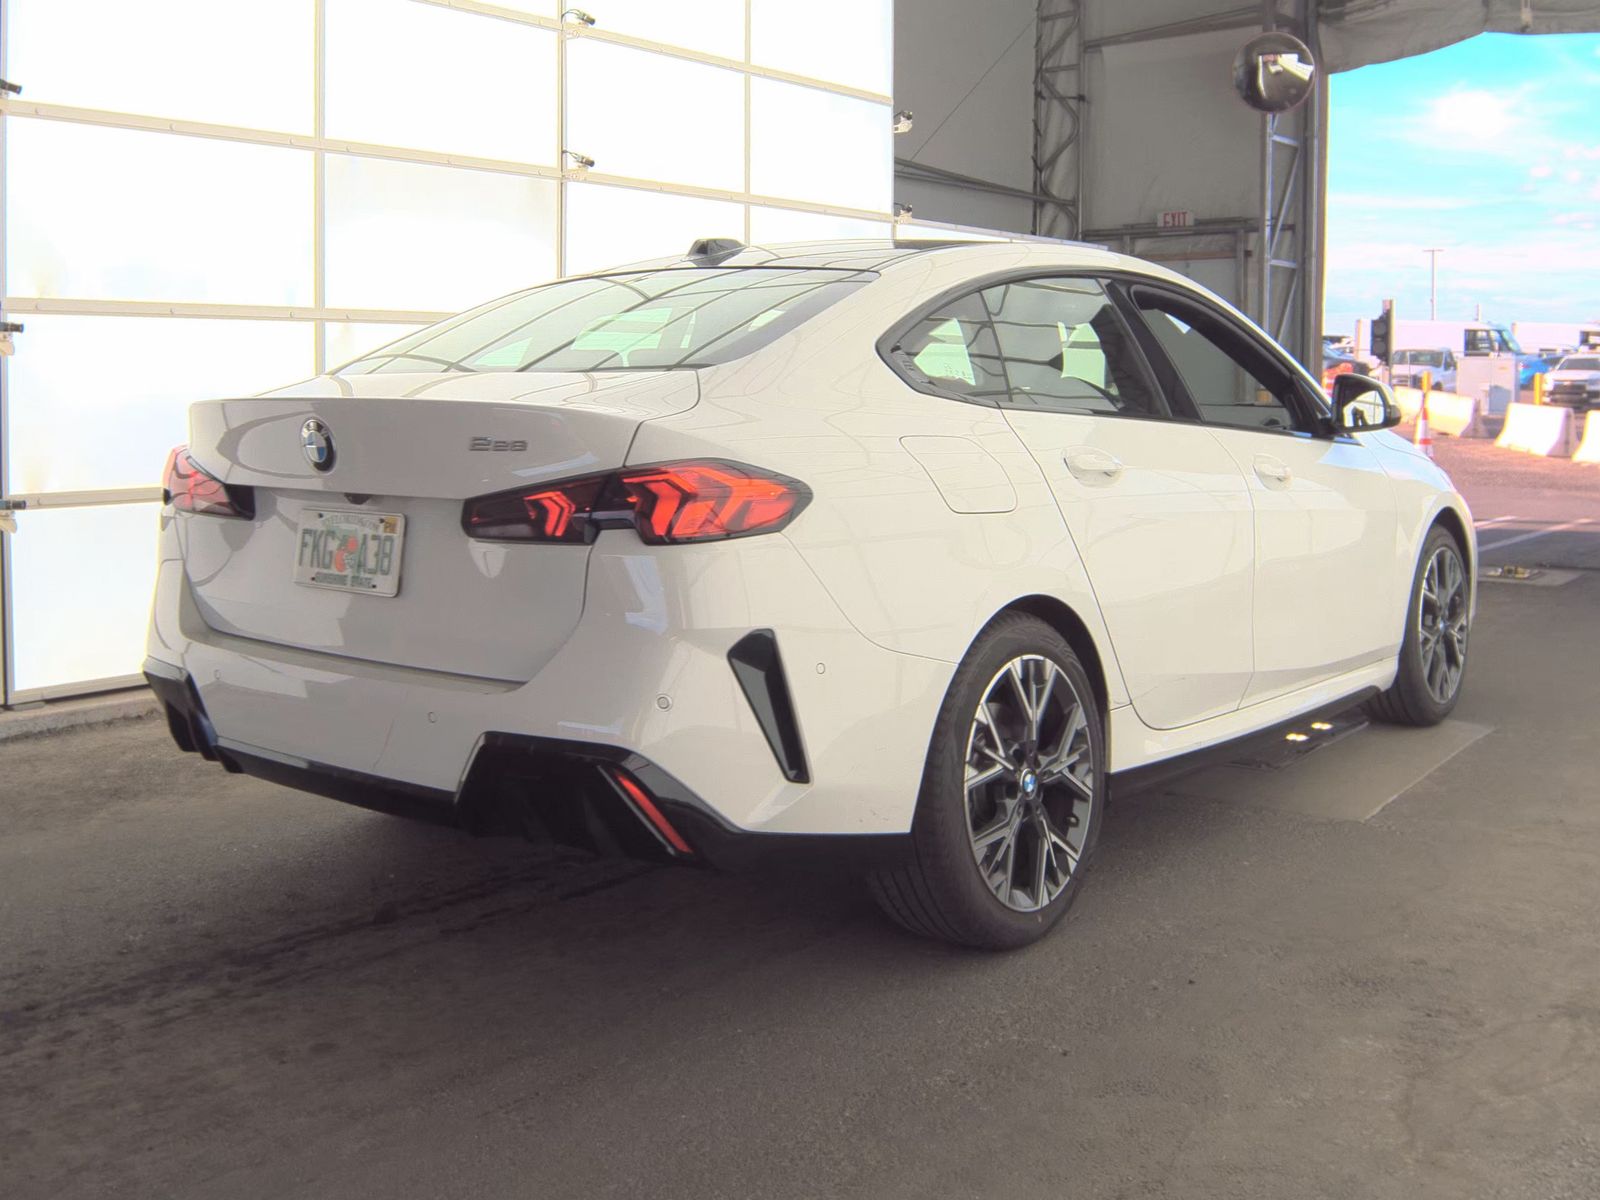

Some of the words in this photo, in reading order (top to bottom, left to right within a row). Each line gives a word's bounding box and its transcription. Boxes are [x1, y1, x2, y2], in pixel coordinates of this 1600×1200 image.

[1163, 211, 1187, 227] EXIT
[469, 436, 528, 452] 228
[298, 528, 336, 570] FKG
